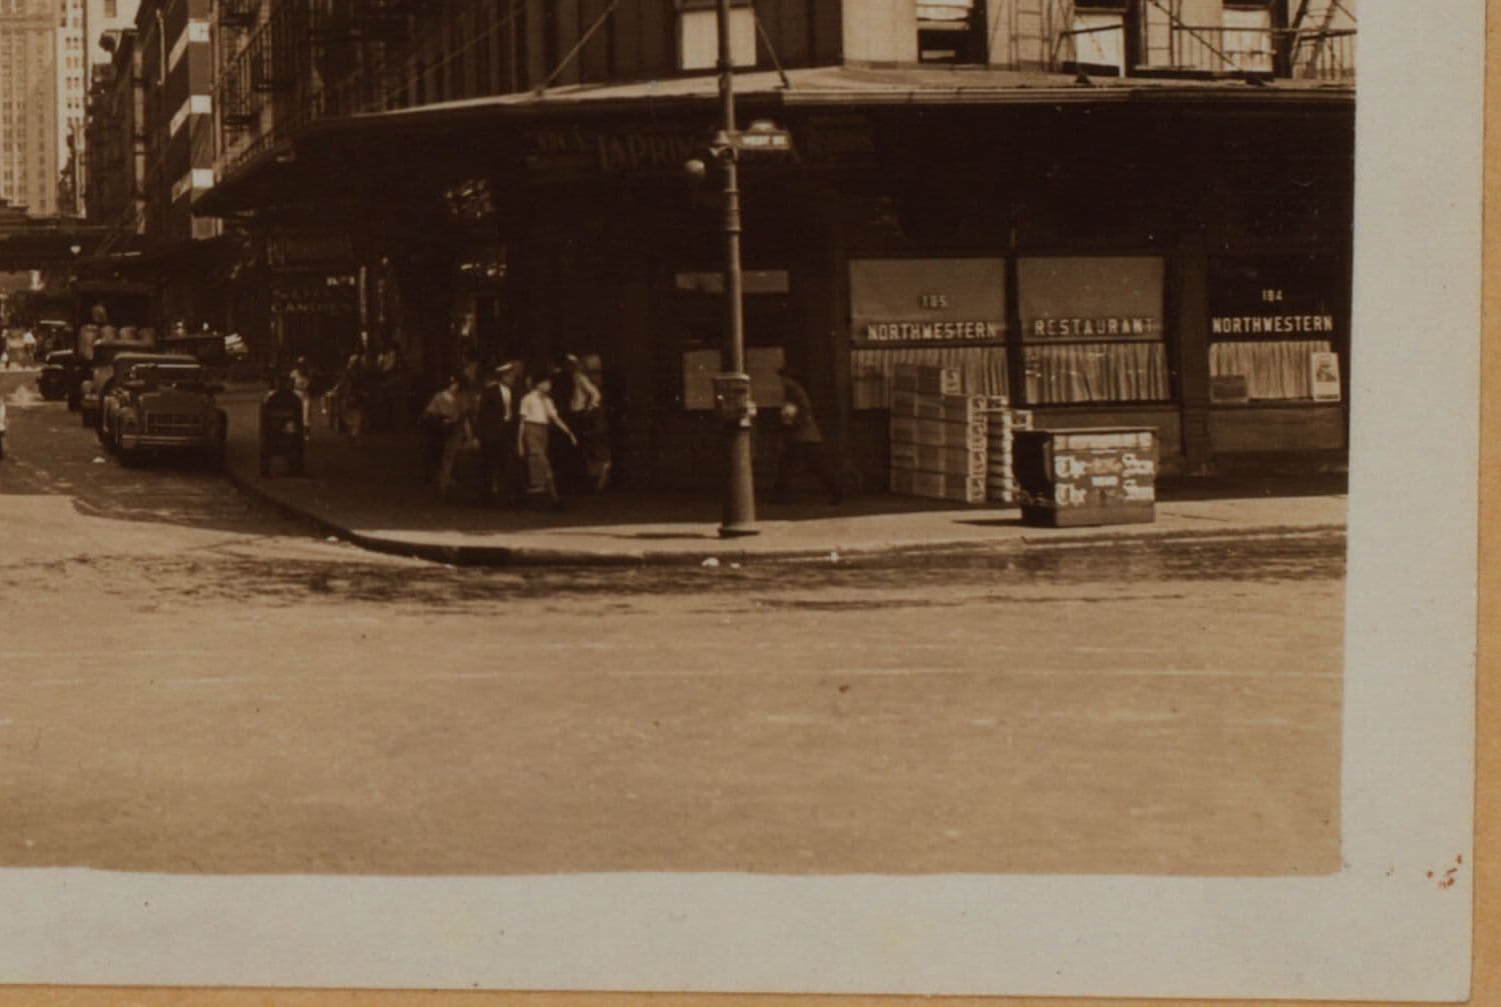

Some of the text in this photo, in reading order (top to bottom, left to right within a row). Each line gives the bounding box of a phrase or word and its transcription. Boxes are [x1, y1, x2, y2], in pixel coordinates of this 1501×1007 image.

[867, 321, 999, 341] NORTHWESTERN
[1034, 318, 1157, 336] RESTAURANT
[1212, 315, 1334, 333] NORTHWESTERN
